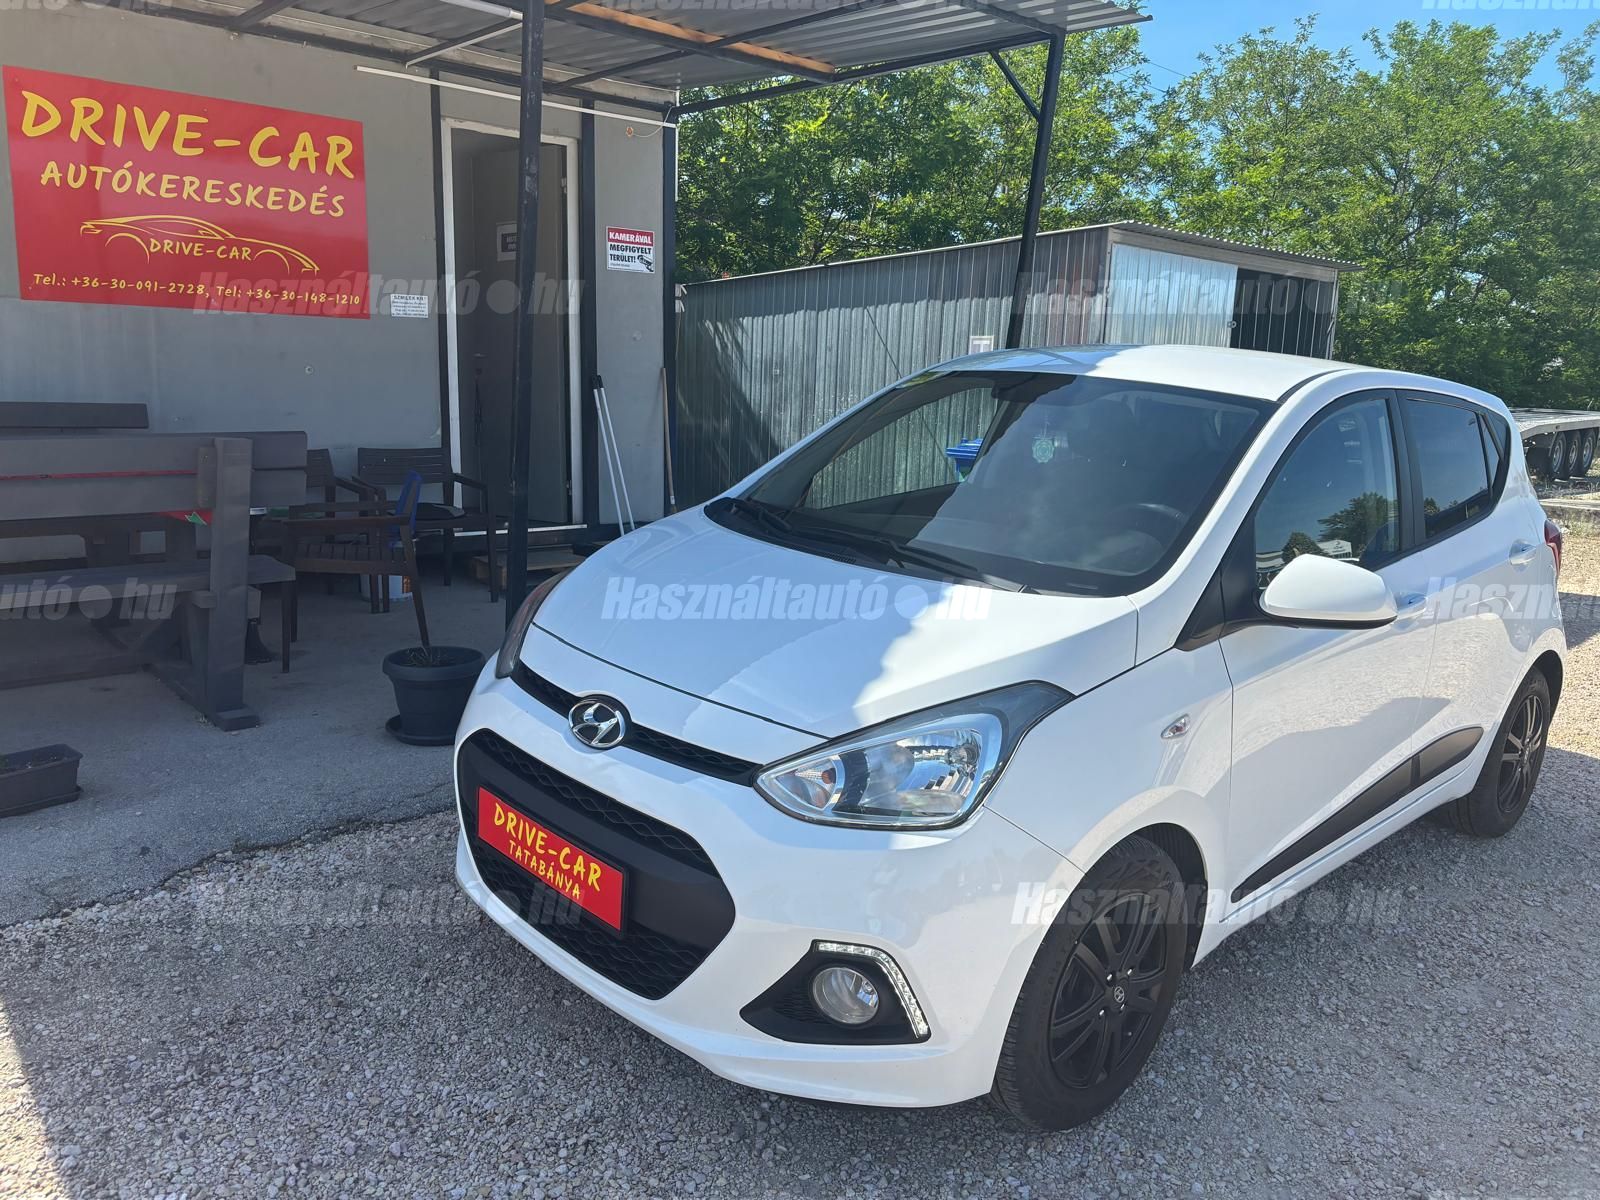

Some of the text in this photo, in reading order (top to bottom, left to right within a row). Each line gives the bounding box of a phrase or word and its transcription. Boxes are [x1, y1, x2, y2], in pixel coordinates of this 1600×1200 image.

[21, 90, 355, 180] DRIVE-CAR
[40, 160, 345, 218] AUTÓKERESKEDÉS
[149, 239, 252, 260] DRIVE-CAR
[609, 231, 652, 244] KAMERÁVAL
[609, 243, 652, 255] MEGFIGYELT
[71, 276, 210, 298] +36-30-091-2728,
[216, 285, 242, 298] Tel:
[246, 288, 361, 305] +36-30-148-1210
[493, 802, 602, 893] DRIVE-CAR
[508, 839, 581, 900] TATABÁNYA
